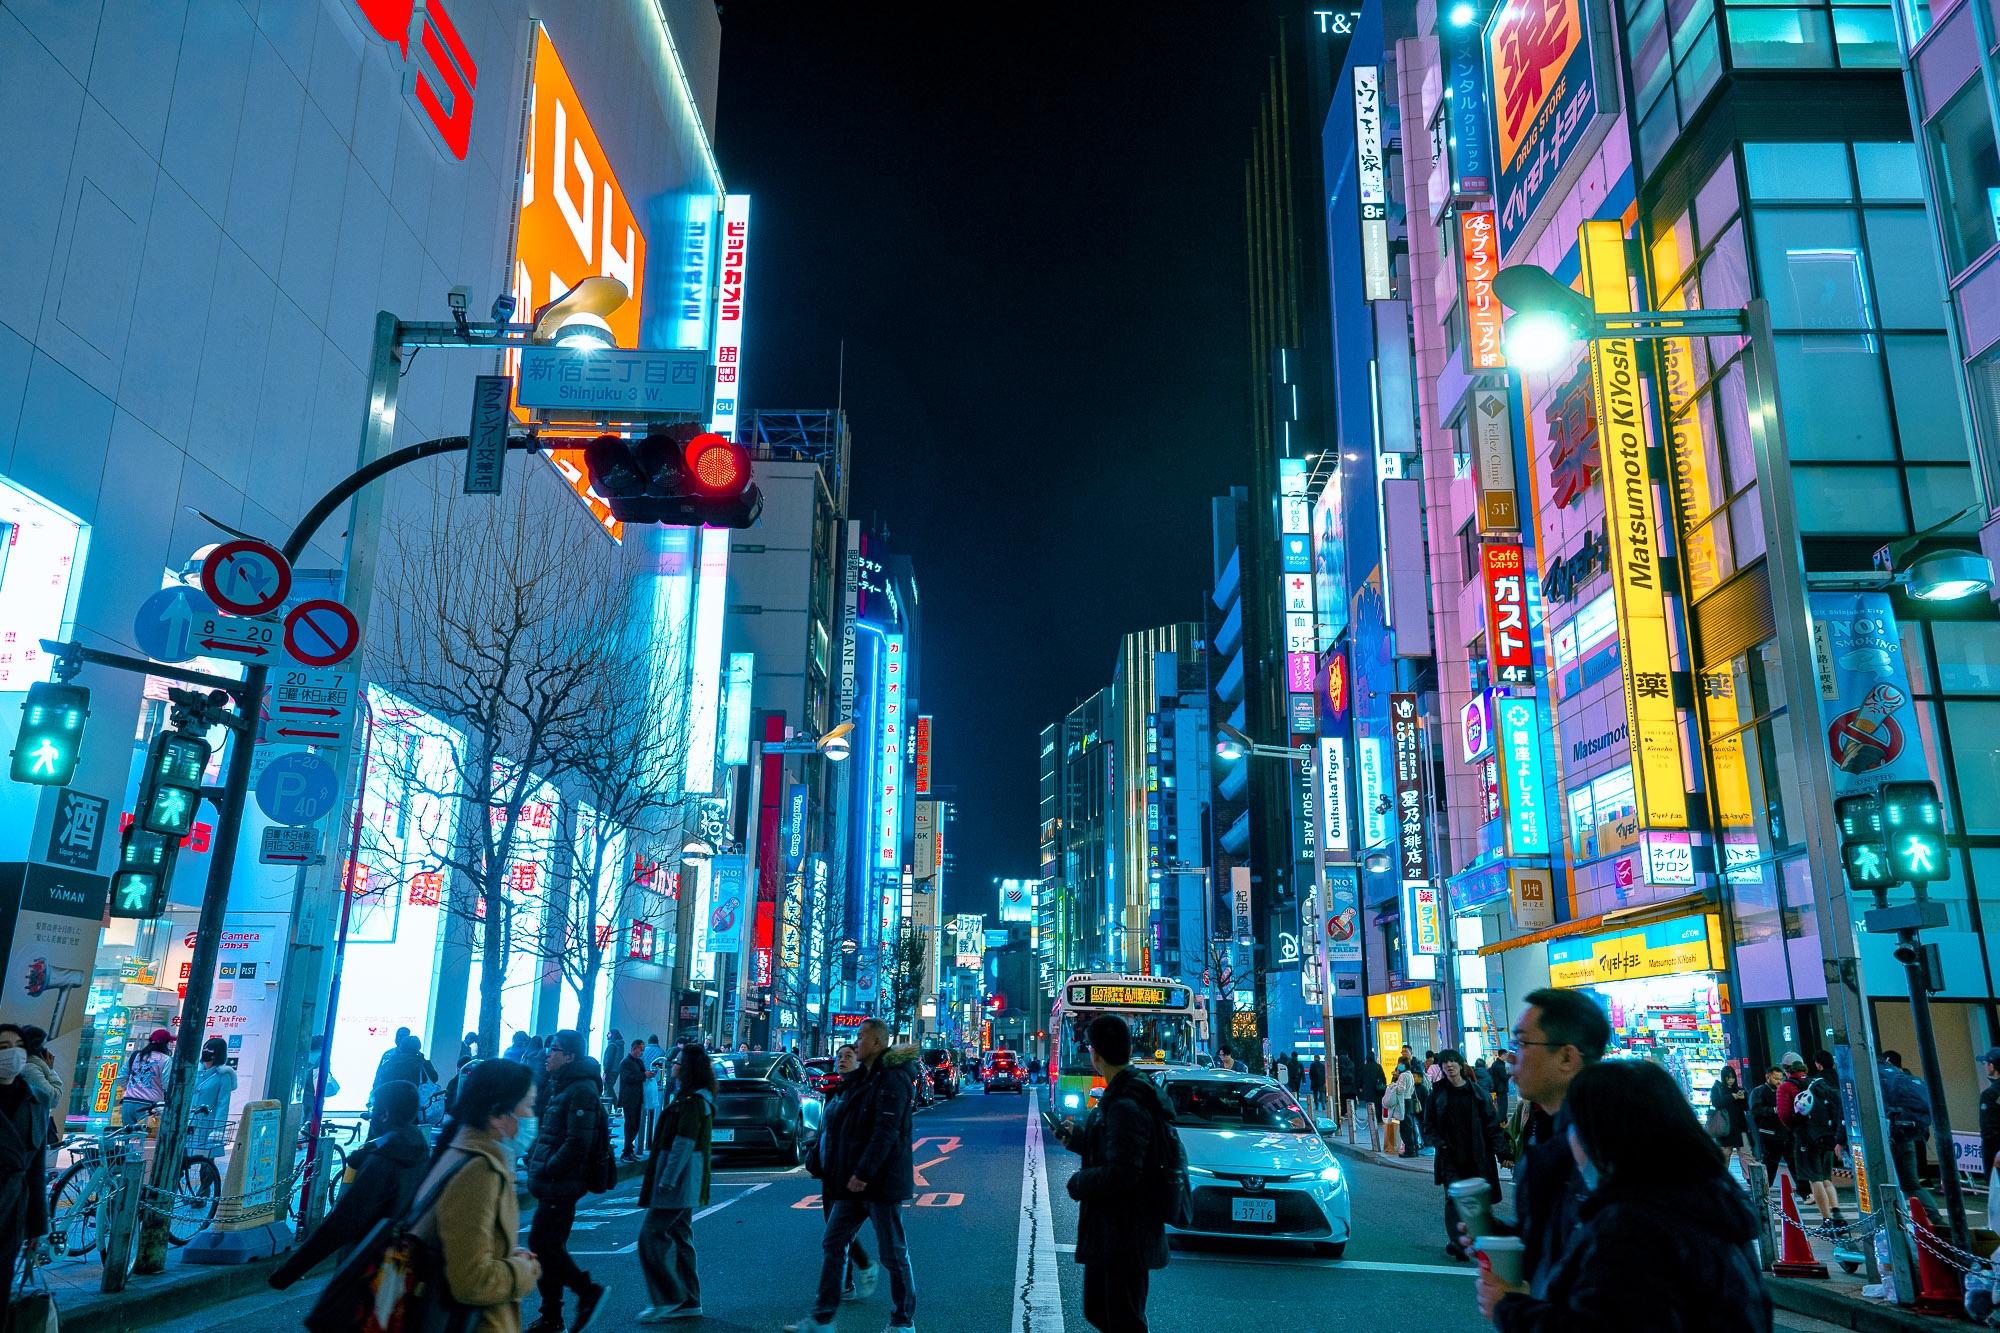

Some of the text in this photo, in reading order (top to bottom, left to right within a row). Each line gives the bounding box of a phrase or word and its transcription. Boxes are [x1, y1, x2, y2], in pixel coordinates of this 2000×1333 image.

[1516, 75, 1566, 173] DRUG STORE
[1363, 205, 1383, 218] 8F
[722, 222, 744, 320] ビックカメラ
[1480, 354, 1496, 366] 8F
[528, 357, 699, 384] 新宿三丁目西
[559, 386, 663, 403] Shinjuku 3 W.
[717, 402, 733, 410] GU
[473, 382, 503, 488] スクランブル交差点
[1488, 423, 1499, 452] Fellez
[1490, 454, 1501, 485] Clinic
[1491, 503, 1510, 515] 5F
[1620, 433, 1652, 590] Matsumoto
[1489, 550, 1518, 561] Café
[1490, 561, 1519, 569] レストラン
[1494, 576, 1524, 658] ガスト
[204, 620, 215, 634] 8
[247, 626, 273, 642] 20
[1831, 619, 1884, 637] NO!
[1835, 637, 1898, 652] SMOKING
[840, 604, 856, 722] MEGANE ICHIBA
[286, 672, 306, 685] 20
[333, 675, 343, 688] 7
[1502, 666, 1527, 682] 4F
[1636, 672, 1669, 699] 薬
[278, 688, 348, 704] 日曜・休日は終日
[1396, 722, 1408, 780] COFFEE
[1573, 722, 1629, 763] Matsumoto
[1407, 722, 1417, 781] HAND DRIP
[1513, 730, 1535, 807] 銀座よしえ
[272, 771, 307, 816] P
[319, 787, 328, 800] 分
[1326, 747, 1341, 839] OnitsukaTiger
[294, 798, 318, 817] 40
[59, 792, 102, 850] 酒
[790, 794, 803, 857] Tax Free Shop
[1401, 789, 1422, 866] 星乃珈琲店
[59, 848, 89, 860] Liquor Sake
[1303, 850, 1315, 858] B2
[1653, 849, 1688, 859] ネイル
[1408, 868, 1422, 878] 2F
[1654, 862, 1689, 872] サロン
[1333, 878, 1352, 887] NO!
[1524, 884, 1539, 897] リゼ
[1419, 889, 1433, 903] 薬
[957, 917, 982, 934] カラオケ
[1421, 906, 1435, 944] ダイコク
[221, 931, 260, 940] Camera
[695, 928, 708, 979] ROLEX
[221, 966, 237, 975] GU
[241, 967, 255, 975] PLST
[1649, 957, 1676, 968] Matsumoto
[214, 1005, 238, 1013] 22:00
[1242, 1207, 1273, 1221] 37-16
